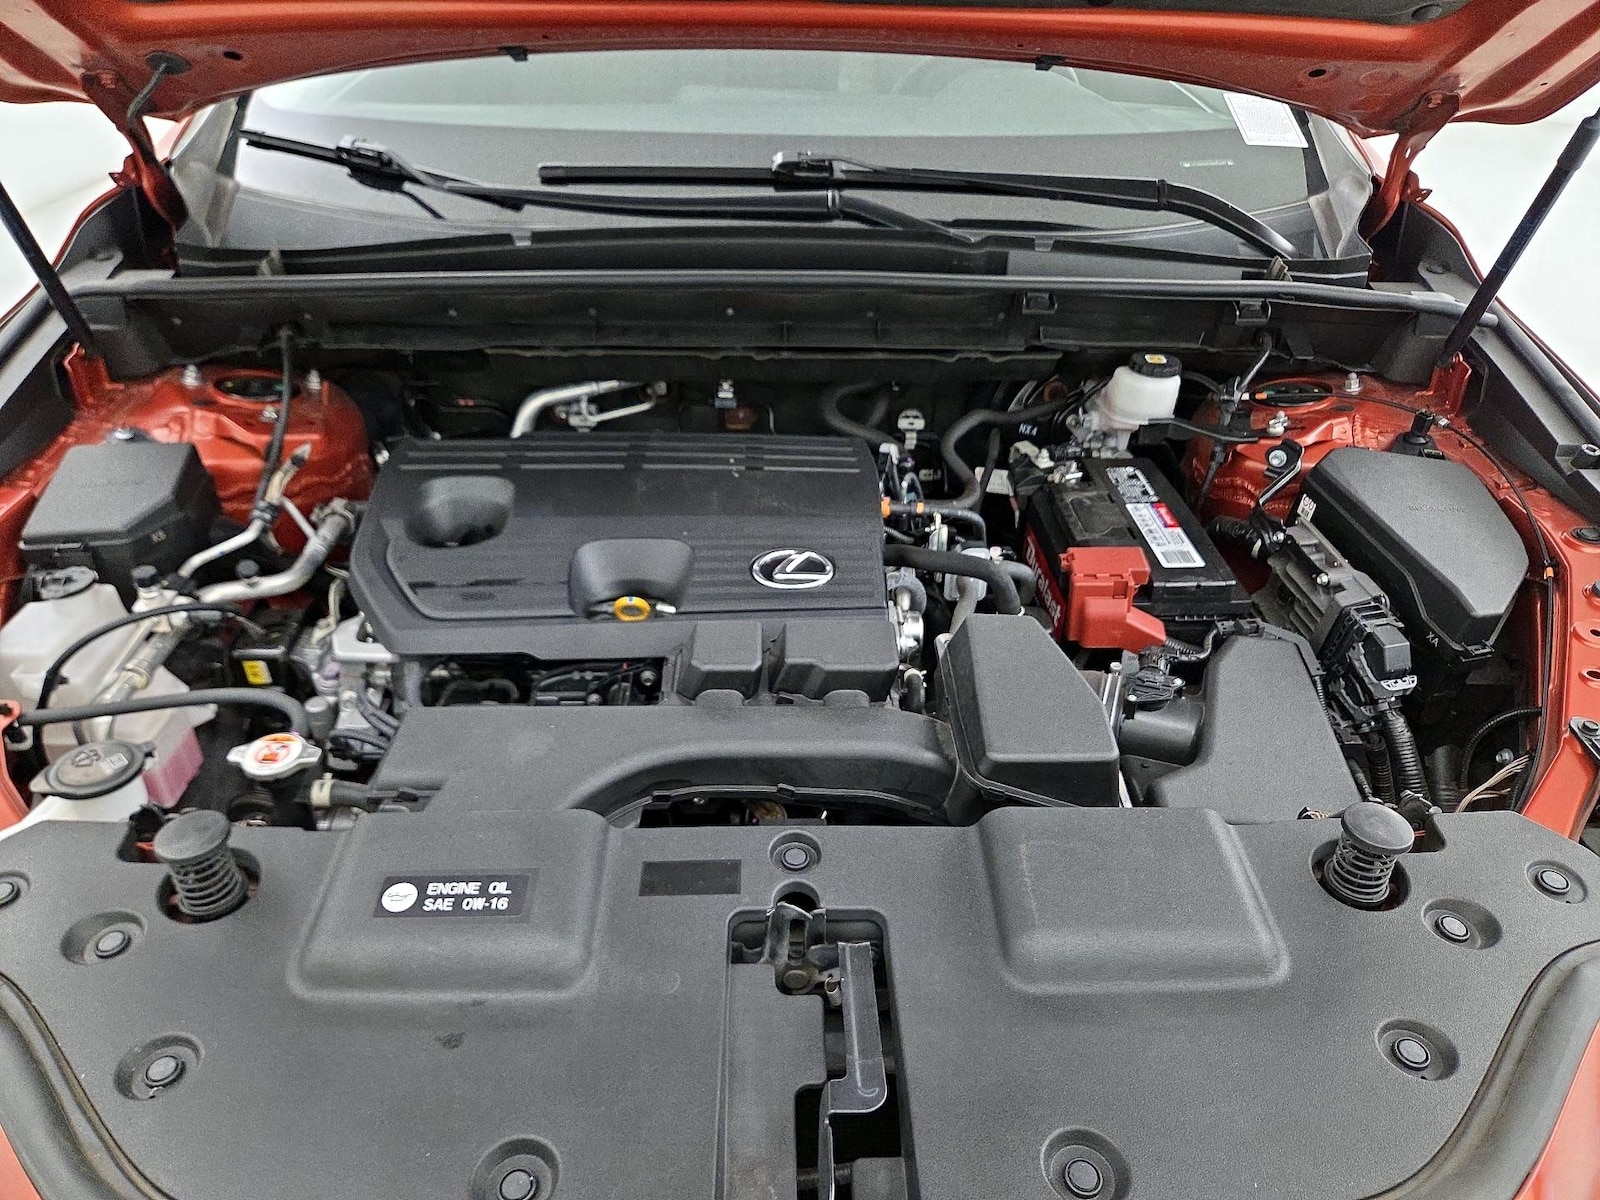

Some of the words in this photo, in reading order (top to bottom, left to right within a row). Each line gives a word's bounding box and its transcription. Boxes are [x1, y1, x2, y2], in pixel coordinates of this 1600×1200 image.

[1026, 536, 1061, 628] Duralast
[426, 881, 482, 896] ENGINE
[487, 881, 512, 895] OIL
[422, 897, 455, 912] SAE
[461, 896, 509, 912] 0W-16
